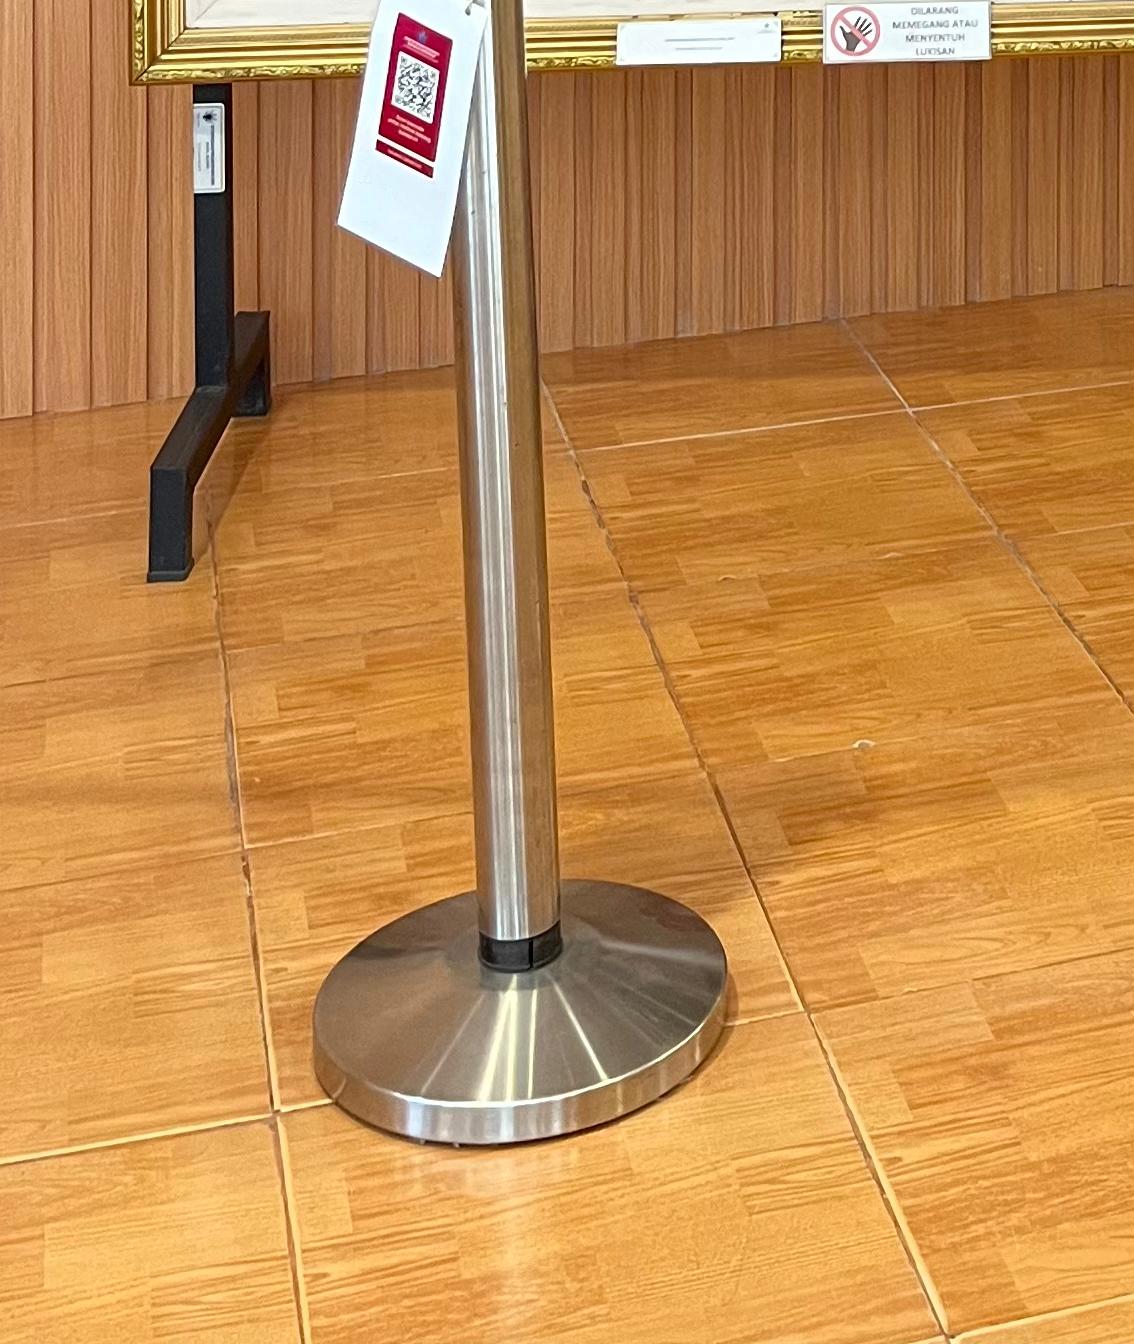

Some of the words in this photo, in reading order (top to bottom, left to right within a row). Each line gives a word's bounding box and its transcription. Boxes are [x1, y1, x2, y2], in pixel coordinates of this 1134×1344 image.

[910, 6, 959, 16] DILARANG
[892, 20, 950, 30] MEMEGANG
[952, 19, 979, 29] ATAU
[905, 33, 966, 43] MENYENTUH
